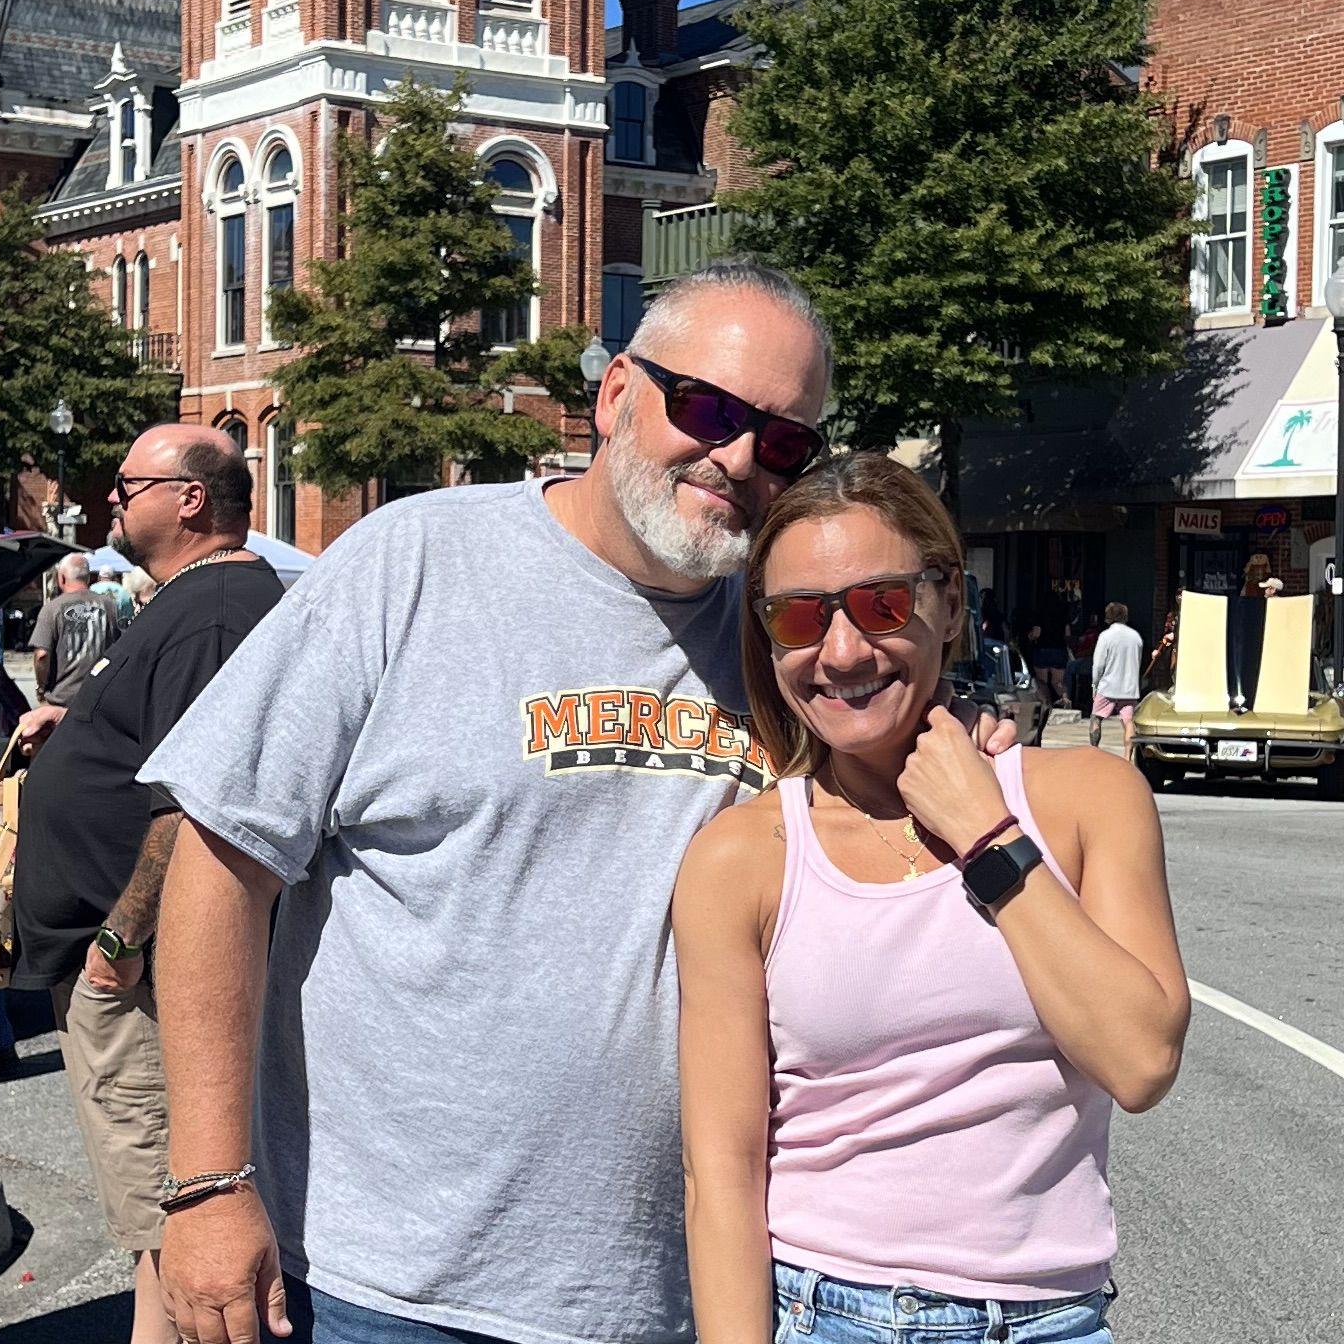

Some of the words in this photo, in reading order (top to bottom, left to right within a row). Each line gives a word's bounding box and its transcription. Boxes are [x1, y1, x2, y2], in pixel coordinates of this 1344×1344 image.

[1260, 168, 1289, 315] TROPICAL
[1178, 512, 1219, 529] NAILS
[1257, 510, 1286, 528] OPEN
[576, 749, 743, 775] BEARS
